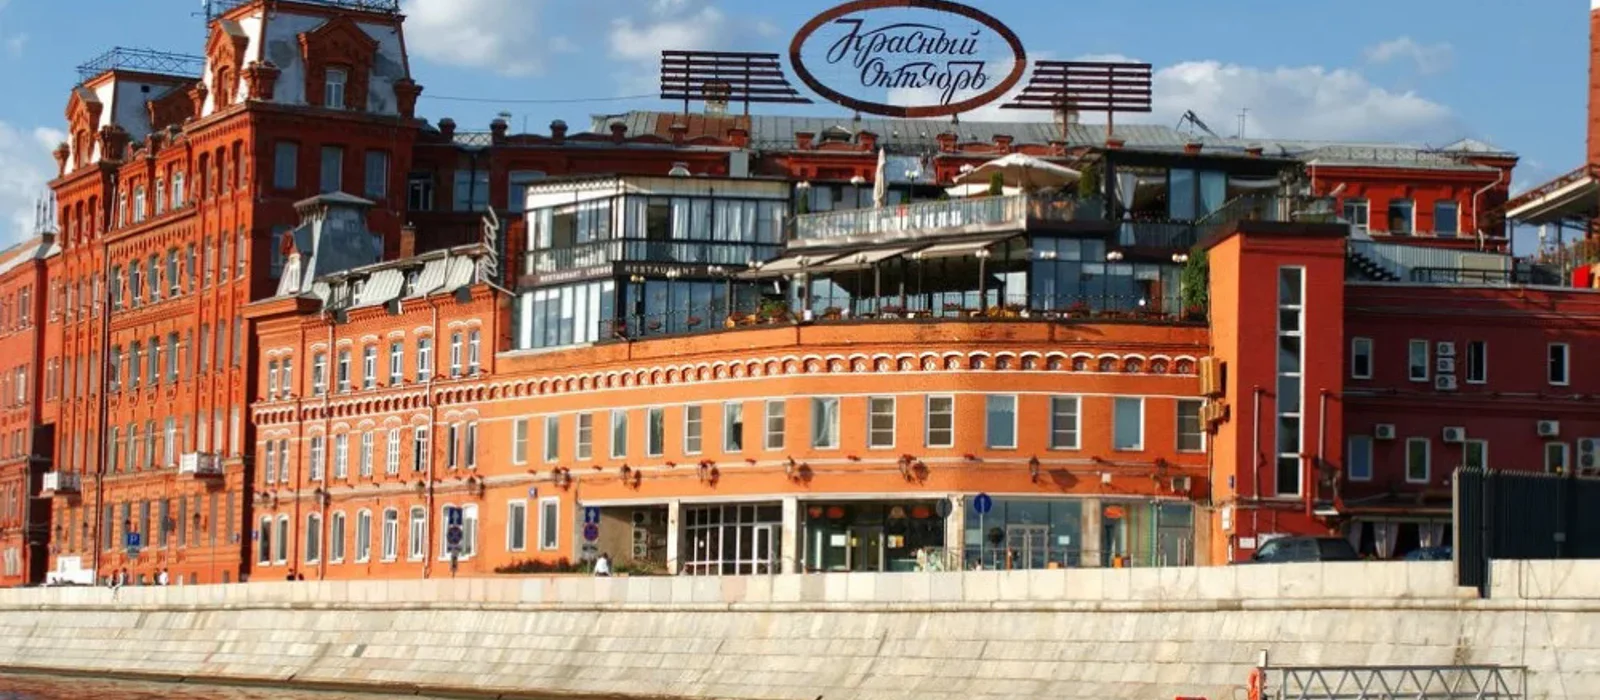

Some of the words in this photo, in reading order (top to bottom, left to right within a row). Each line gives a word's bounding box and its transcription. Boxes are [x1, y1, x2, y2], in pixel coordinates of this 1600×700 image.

[826, 18, 980, 68] Красный
[860, 57, 988, 106] Октябрь
[539, 269, 582, 283] RESTAURANT
